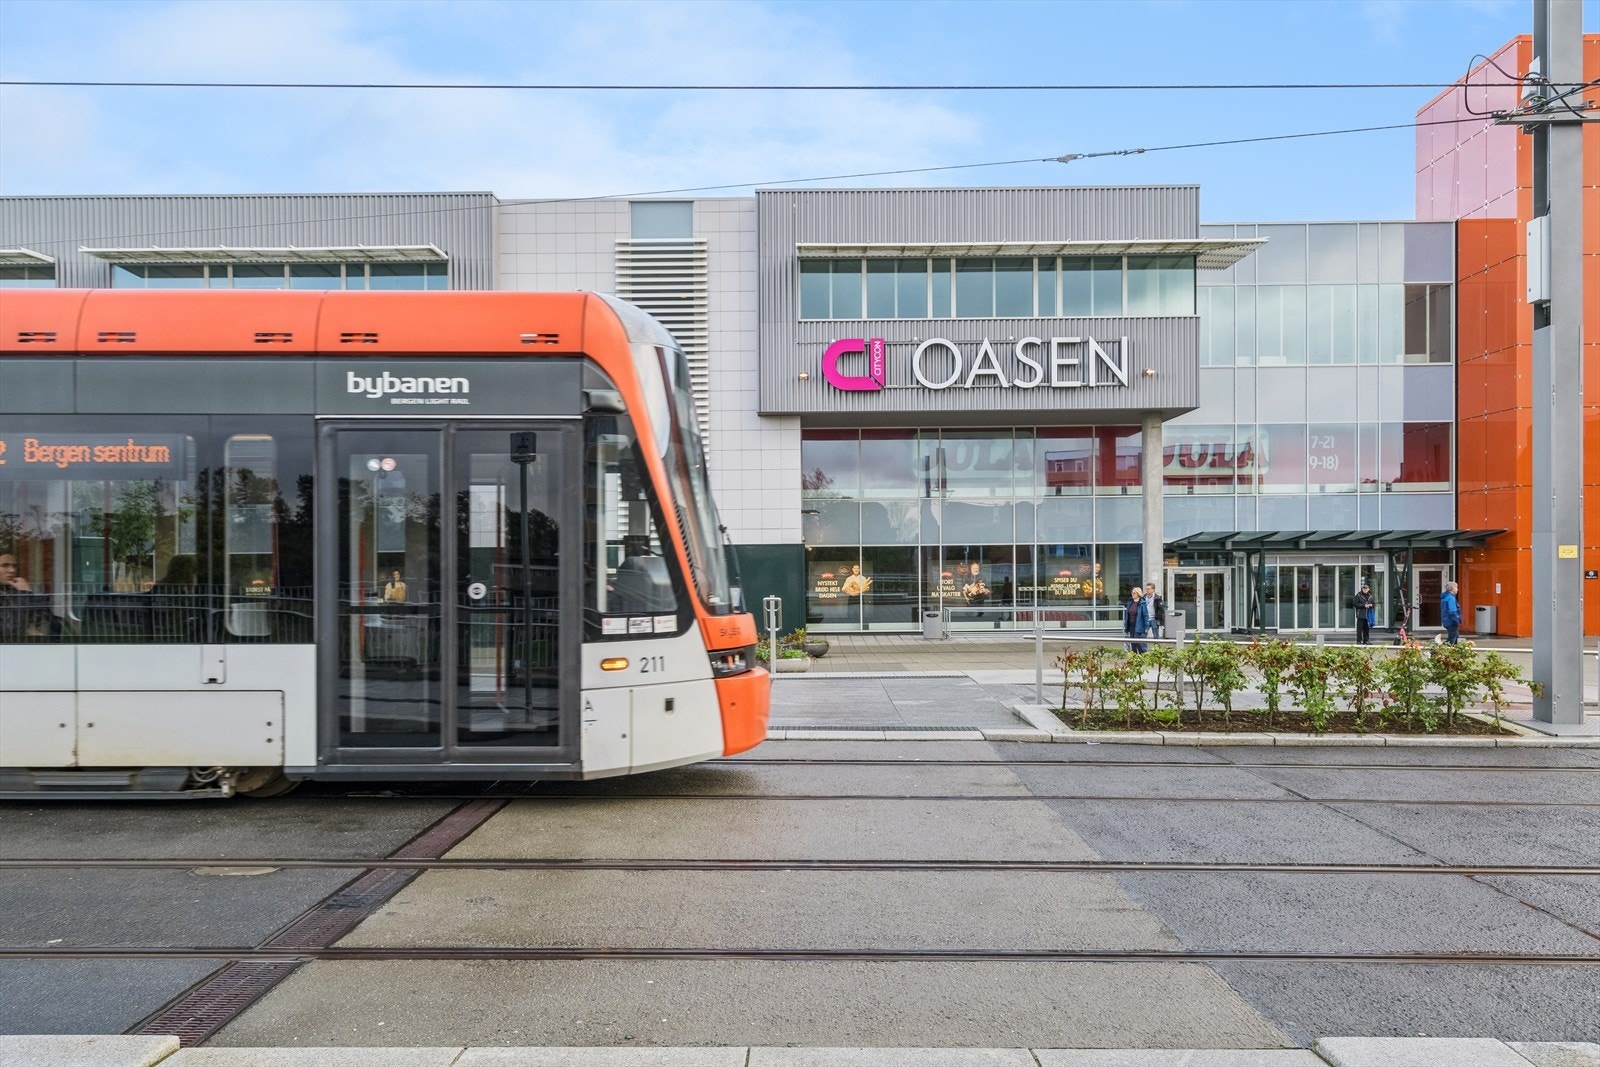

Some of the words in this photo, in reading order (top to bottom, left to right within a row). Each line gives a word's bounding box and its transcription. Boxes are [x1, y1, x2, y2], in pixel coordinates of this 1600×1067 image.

[873, 340, 882, 376] CITYCON
[912, 336, 1129, 390] OASEN
[346, 371, 470, 399] bybanen
[24, 438, 91, 469] Bergen
[93, 438, 170, 463] sentrum
[1310, 435, 1335, 449] 7-21
[1308, 455, 1339, 472] (9-18)
[640, 655, 665, 674] 211
